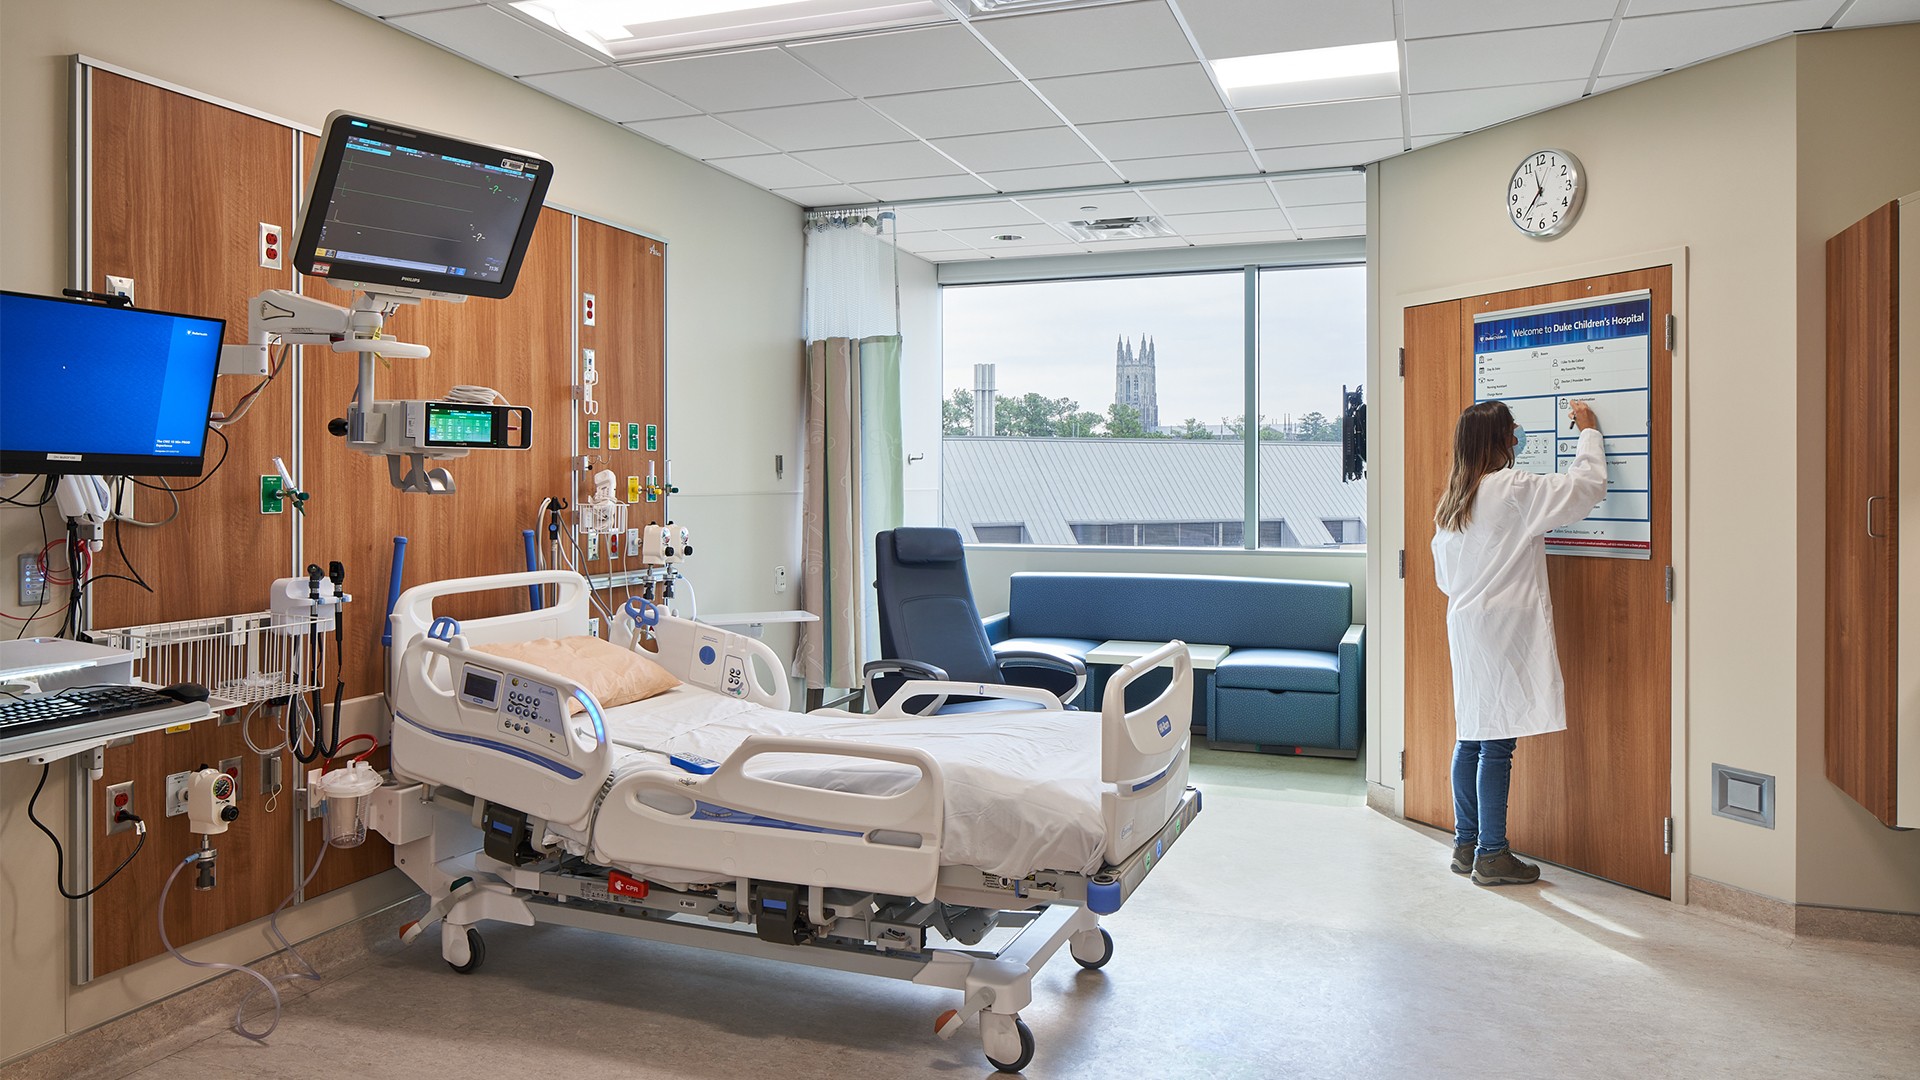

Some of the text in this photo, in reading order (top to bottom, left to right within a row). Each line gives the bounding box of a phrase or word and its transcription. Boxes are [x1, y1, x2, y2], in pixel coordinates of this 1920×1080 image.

[1536, 154, 1546, 166] 12
[1551, 156, 1555, 167] 1
[1525, 163, 1532, 174] 11
[1561, 165, 1567, 176] 2
[1514, 177, 1523, 189] 10
[1565, 180, 1572, 191] 3
[1512, 194, 1518, 205] 9
[1562, 196, 1568, 207] 4
[1516, 208, 1522, 218] 8
[1552, 211, 1558, 222] 5
[1527, 218, 1532, 229] 7
[1539, 218, 1545, 229] 6
[1512, 312, 1644, 337] Welcome to Duke Children's Hospital
[626, 884, 638, 892] CPR
